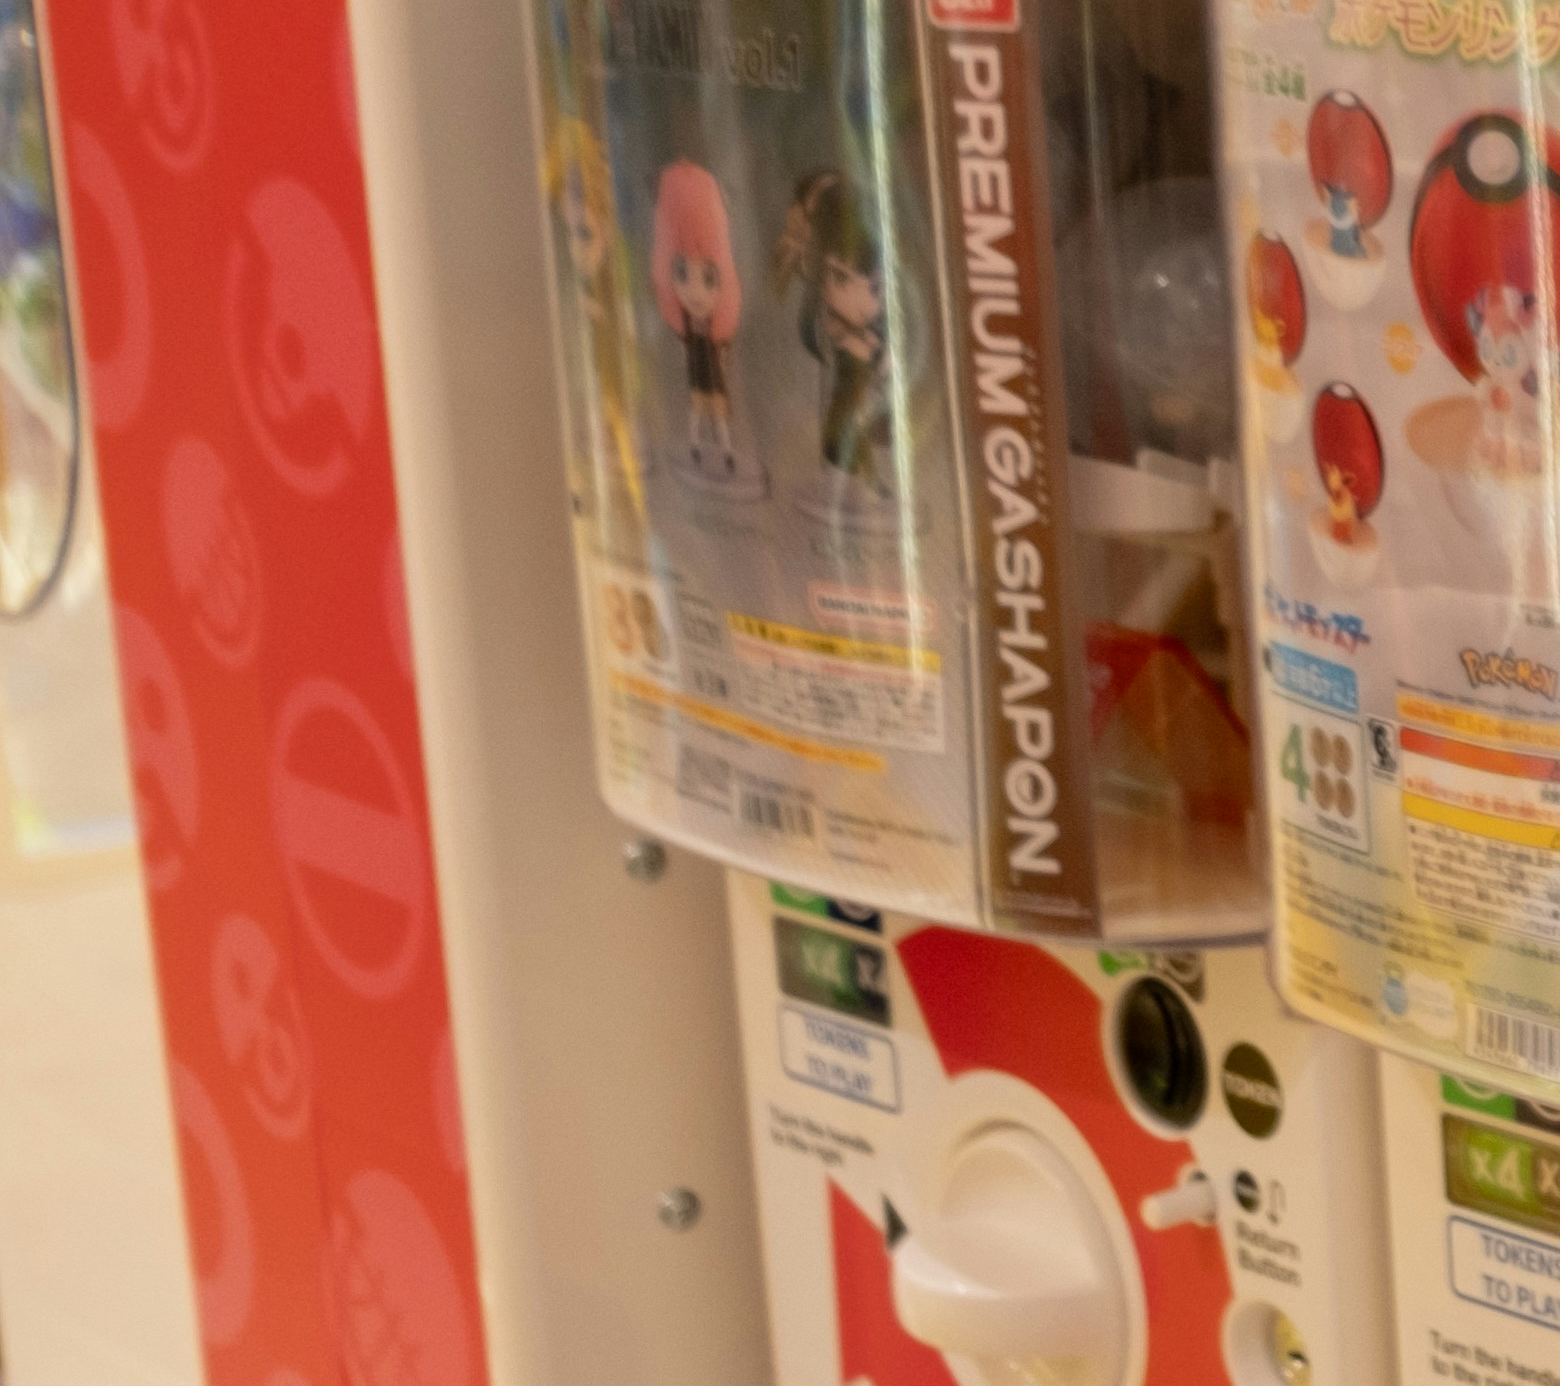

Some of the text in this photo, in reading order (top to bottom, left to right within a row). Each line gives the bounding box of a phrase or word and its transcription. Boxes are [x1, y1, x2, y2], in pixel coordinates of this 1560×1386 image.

[948, 41, 1062, 877] PREMIUM GASHAPON
[1280, 723, 1310, 804] 4
